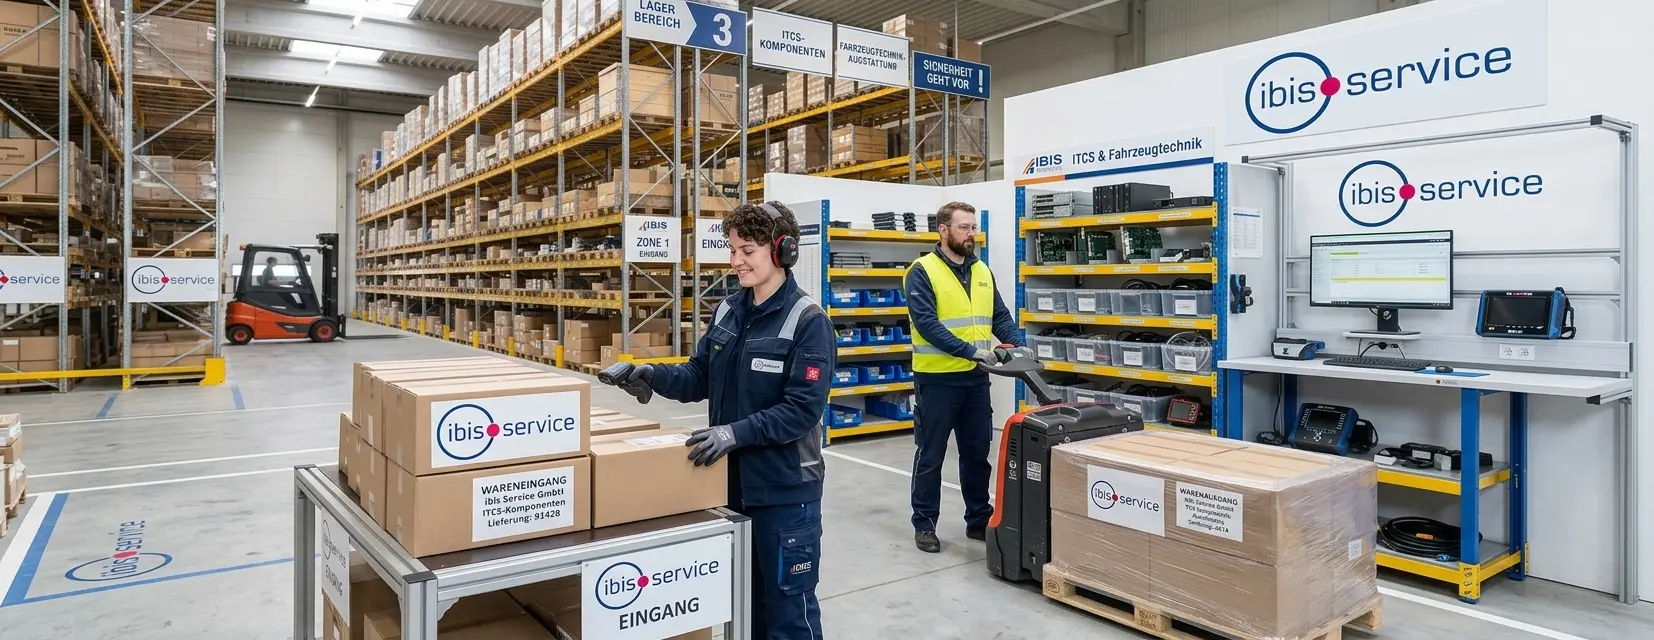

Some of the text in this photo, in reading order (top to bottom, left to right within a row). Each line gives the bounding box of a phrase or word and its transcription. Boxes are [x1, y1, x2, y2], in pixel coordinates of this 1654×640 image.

[640, 0, 675, 14] LAGER
[634, 12, 680, 29] BEREICH
[712, 13, 732, 47] 3
[782, 30, 806, 42] ITCS-
[760, 39, 826, 58] KOMPONENTEN
[926, 73, 970, 90] GEHT VOR
[1260, 46, 1512, 109] ibis service
[1072, 137, 1202, 165] ITCS & Fahrzeugtechnik
[1036, 154, 1063, 167] IBIS
[1351, 170, 1543, 205] ibis service
[636, 237, 669, 247] ZONE 1
[10, 274, 60, 284] service
[138, 274, 215, 285] ibis service
[448, 414, 575, 442] ibis service
[481, 476, 567, 495] WARENEINGANG
[1119, 494, 1160, 512] service
[488, 510, 561, 528] Lieferung: 91428
[604, 560, 719, 596] ibis service
[620, 597, 699, 630] EINGANG
